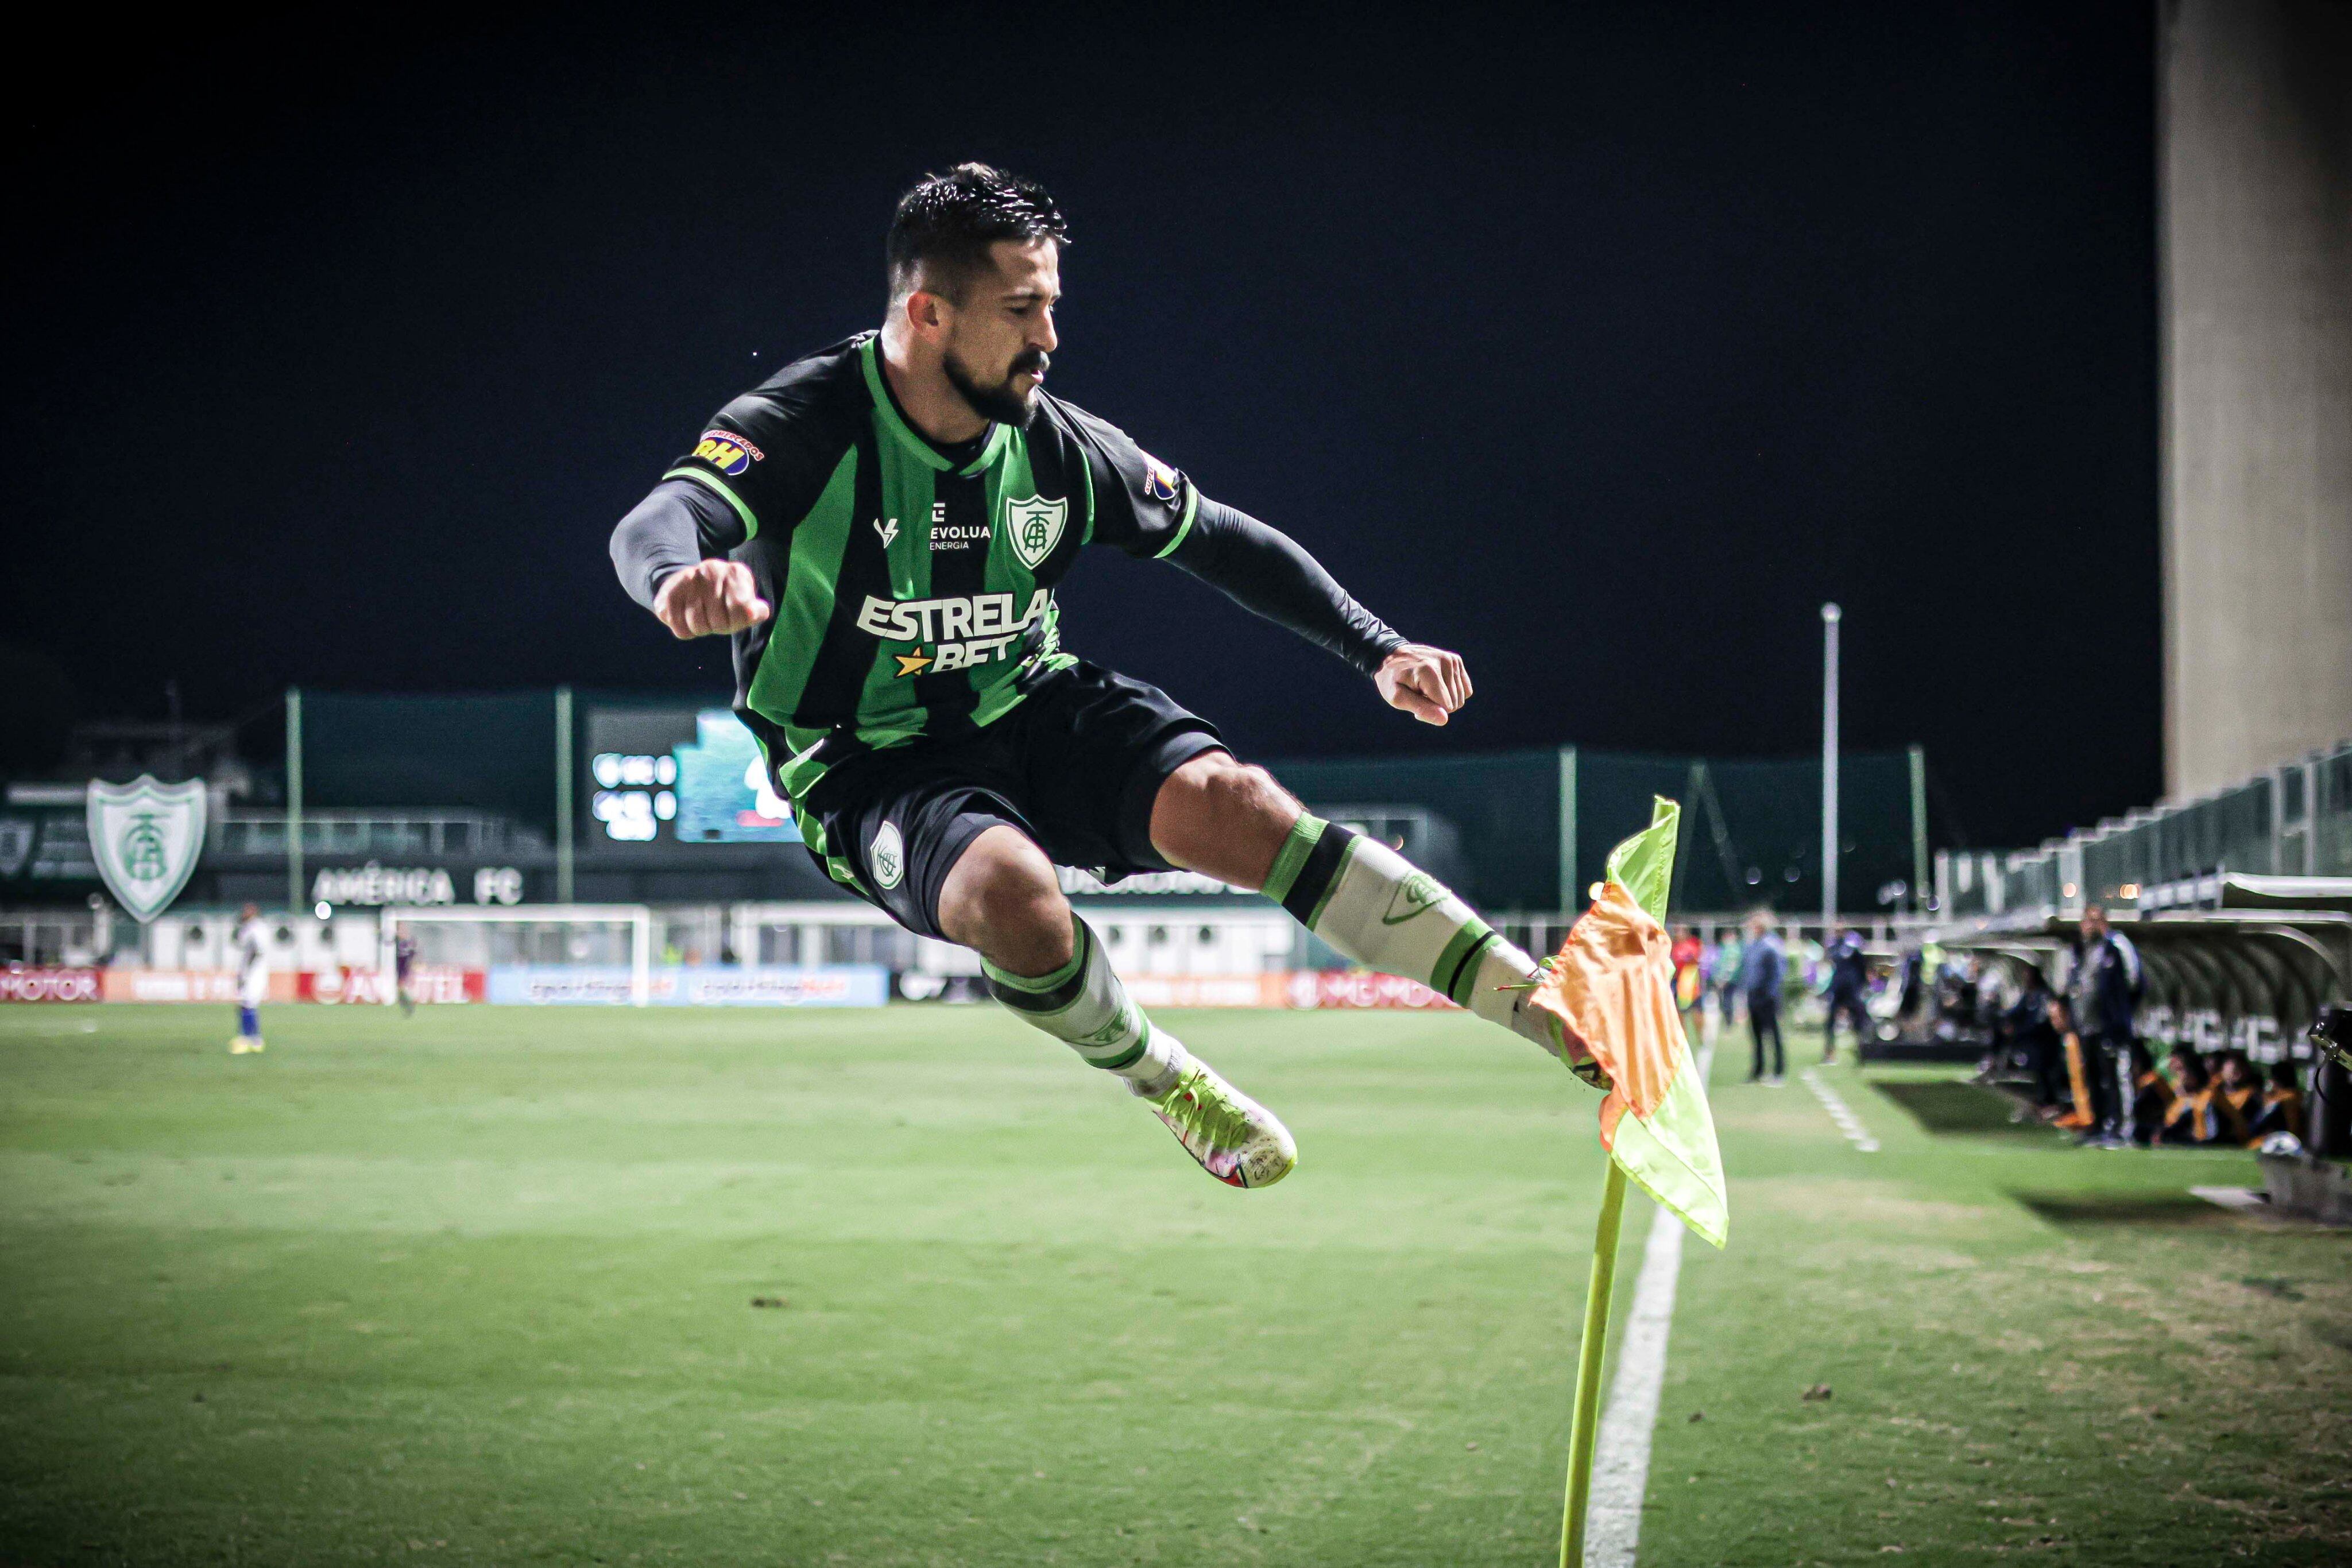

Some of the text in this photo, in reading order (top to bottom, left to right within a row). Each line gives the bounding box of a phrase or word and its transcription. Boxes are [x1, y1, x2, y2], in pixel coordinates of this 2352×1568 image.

[929, 541, 969, 551] ENERGIA
[930, 526, 991, 539] EVOLUA
[856, 588, 1049, 642] ESTRELA
[929, 633, 1019, 673] BET
[474, 866, 524, 905] FC
